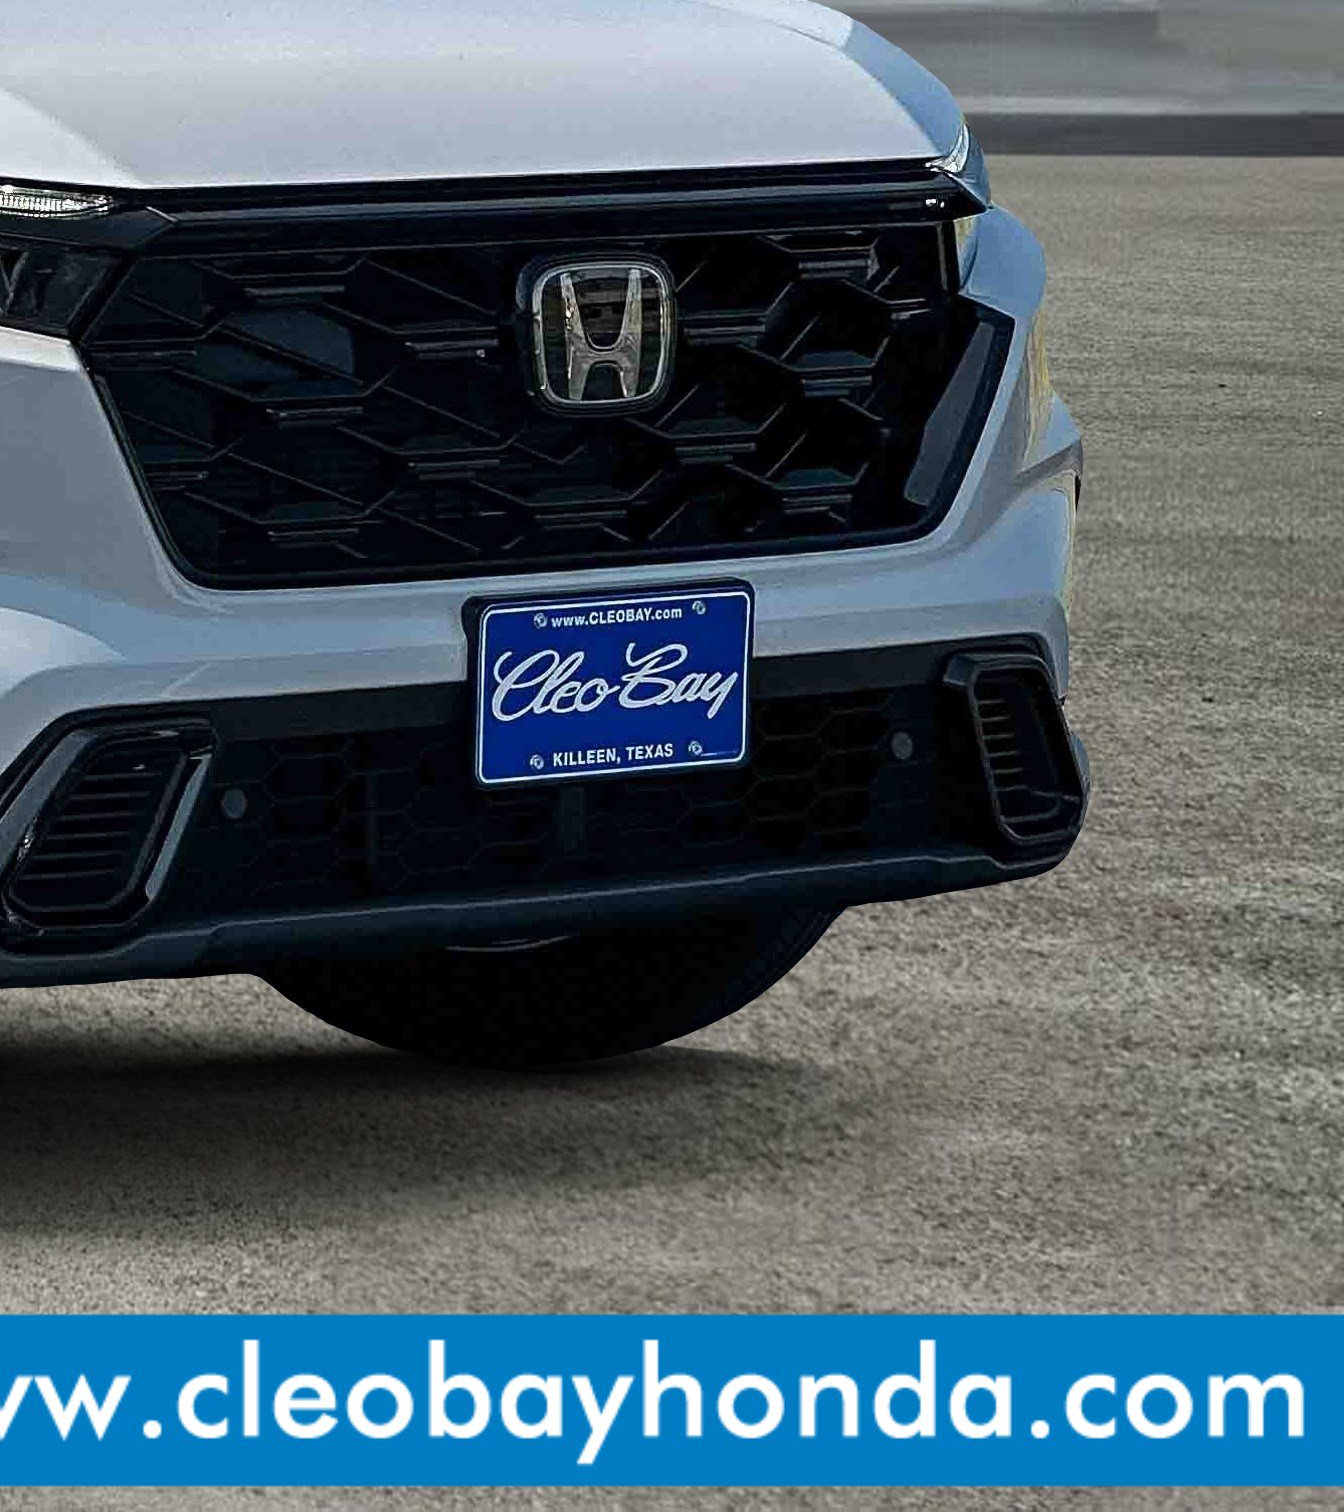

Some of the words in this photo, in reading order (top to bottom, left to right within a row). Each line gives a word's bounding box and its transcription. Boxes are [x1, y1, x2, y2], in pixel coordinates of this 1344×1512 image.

[551, 606, 683, 628] www.CLEOBAY.com
[492, 649, 620, 721] Cleo
[618, 642, 739, 719] Bay
[552, 747, 622, 768] KILLEEN,
[626, 743, 675, 762] TEXAS
